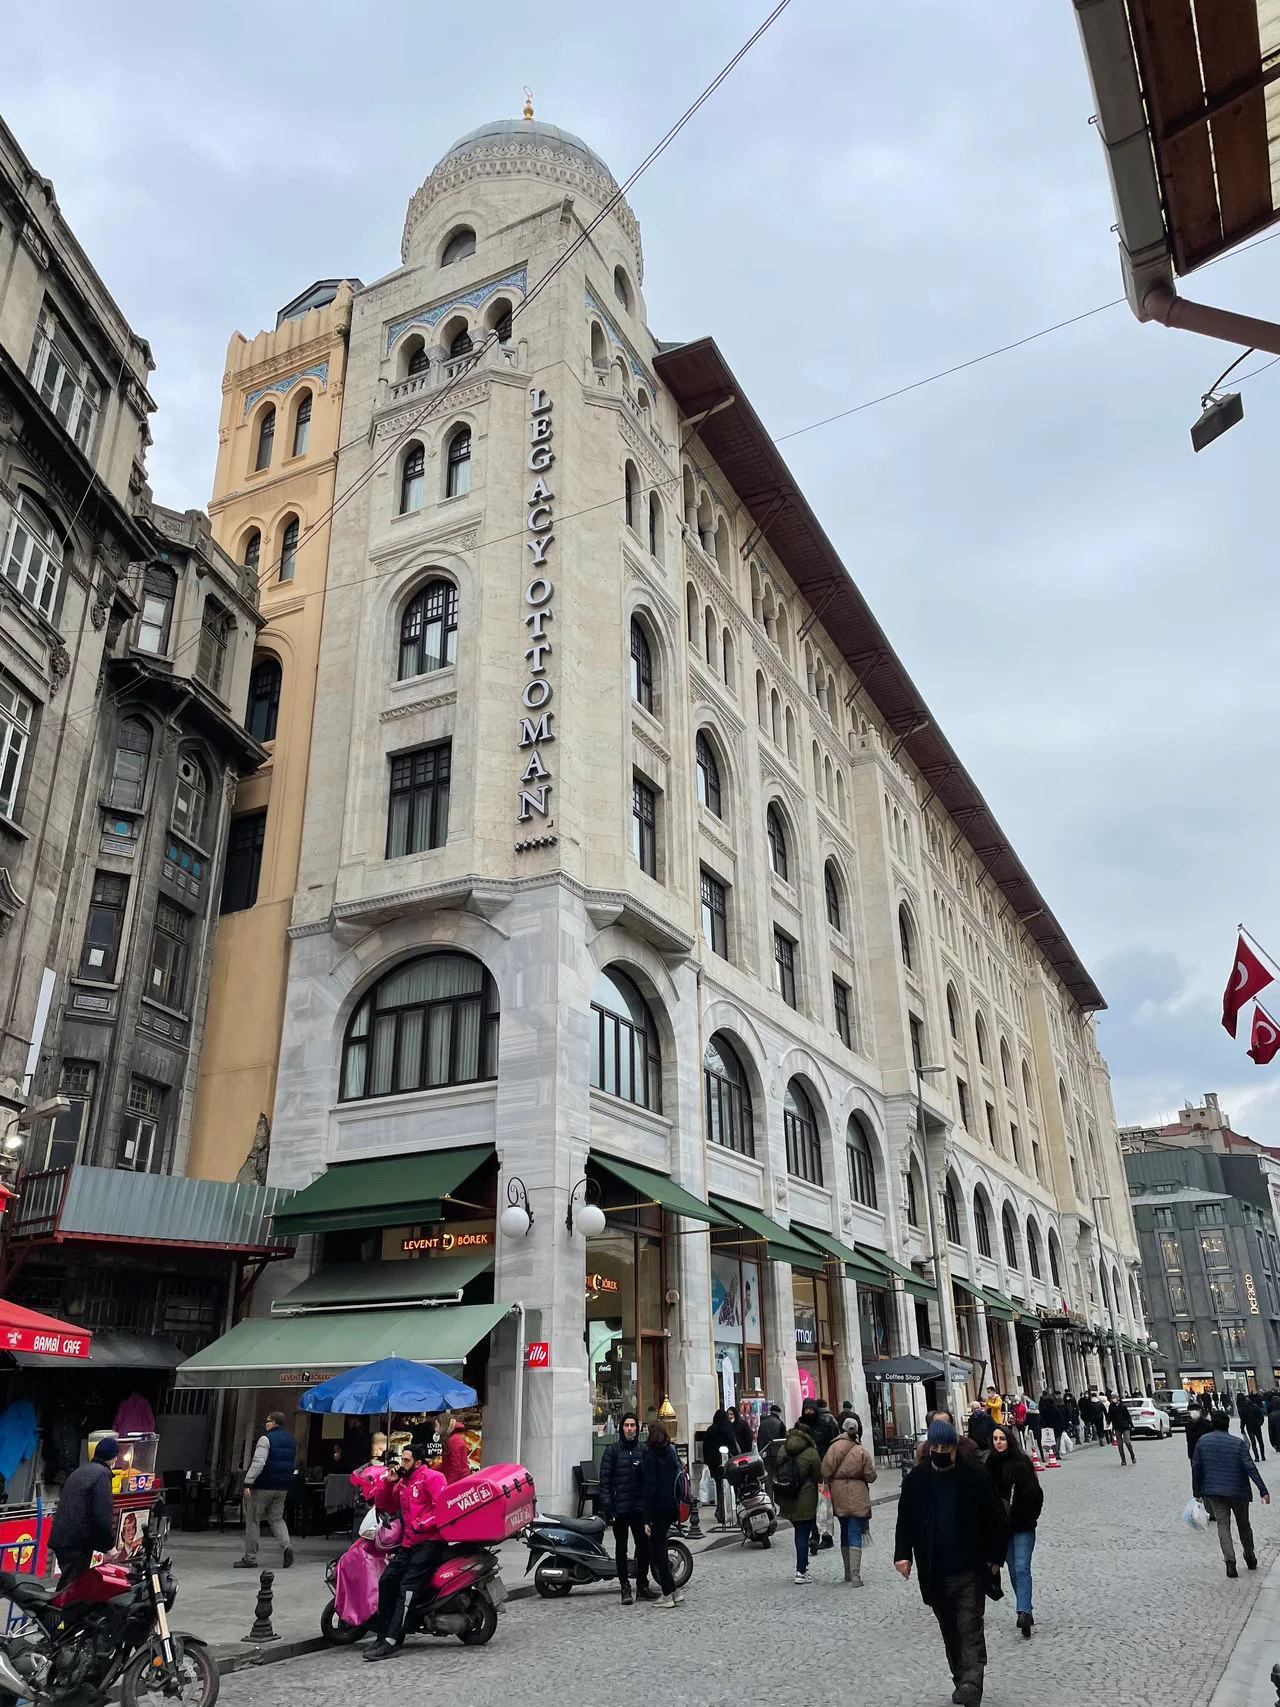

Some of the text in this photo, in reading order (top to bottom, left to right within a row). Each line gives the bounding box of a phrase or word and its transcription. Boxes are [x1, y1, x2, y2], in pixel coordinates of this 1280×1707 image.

[517, 388, 555, 822] LEGACY OTTOMAN
[404, 1238, 439, 1250] LEVENT
[457, 1234, 488, 1245] BÖREK
[1245, 1274, 1259, 1315] DeFacto
[530, 1345, 547, 1364] illy
[457, 1492, 480, 1511] VALE
